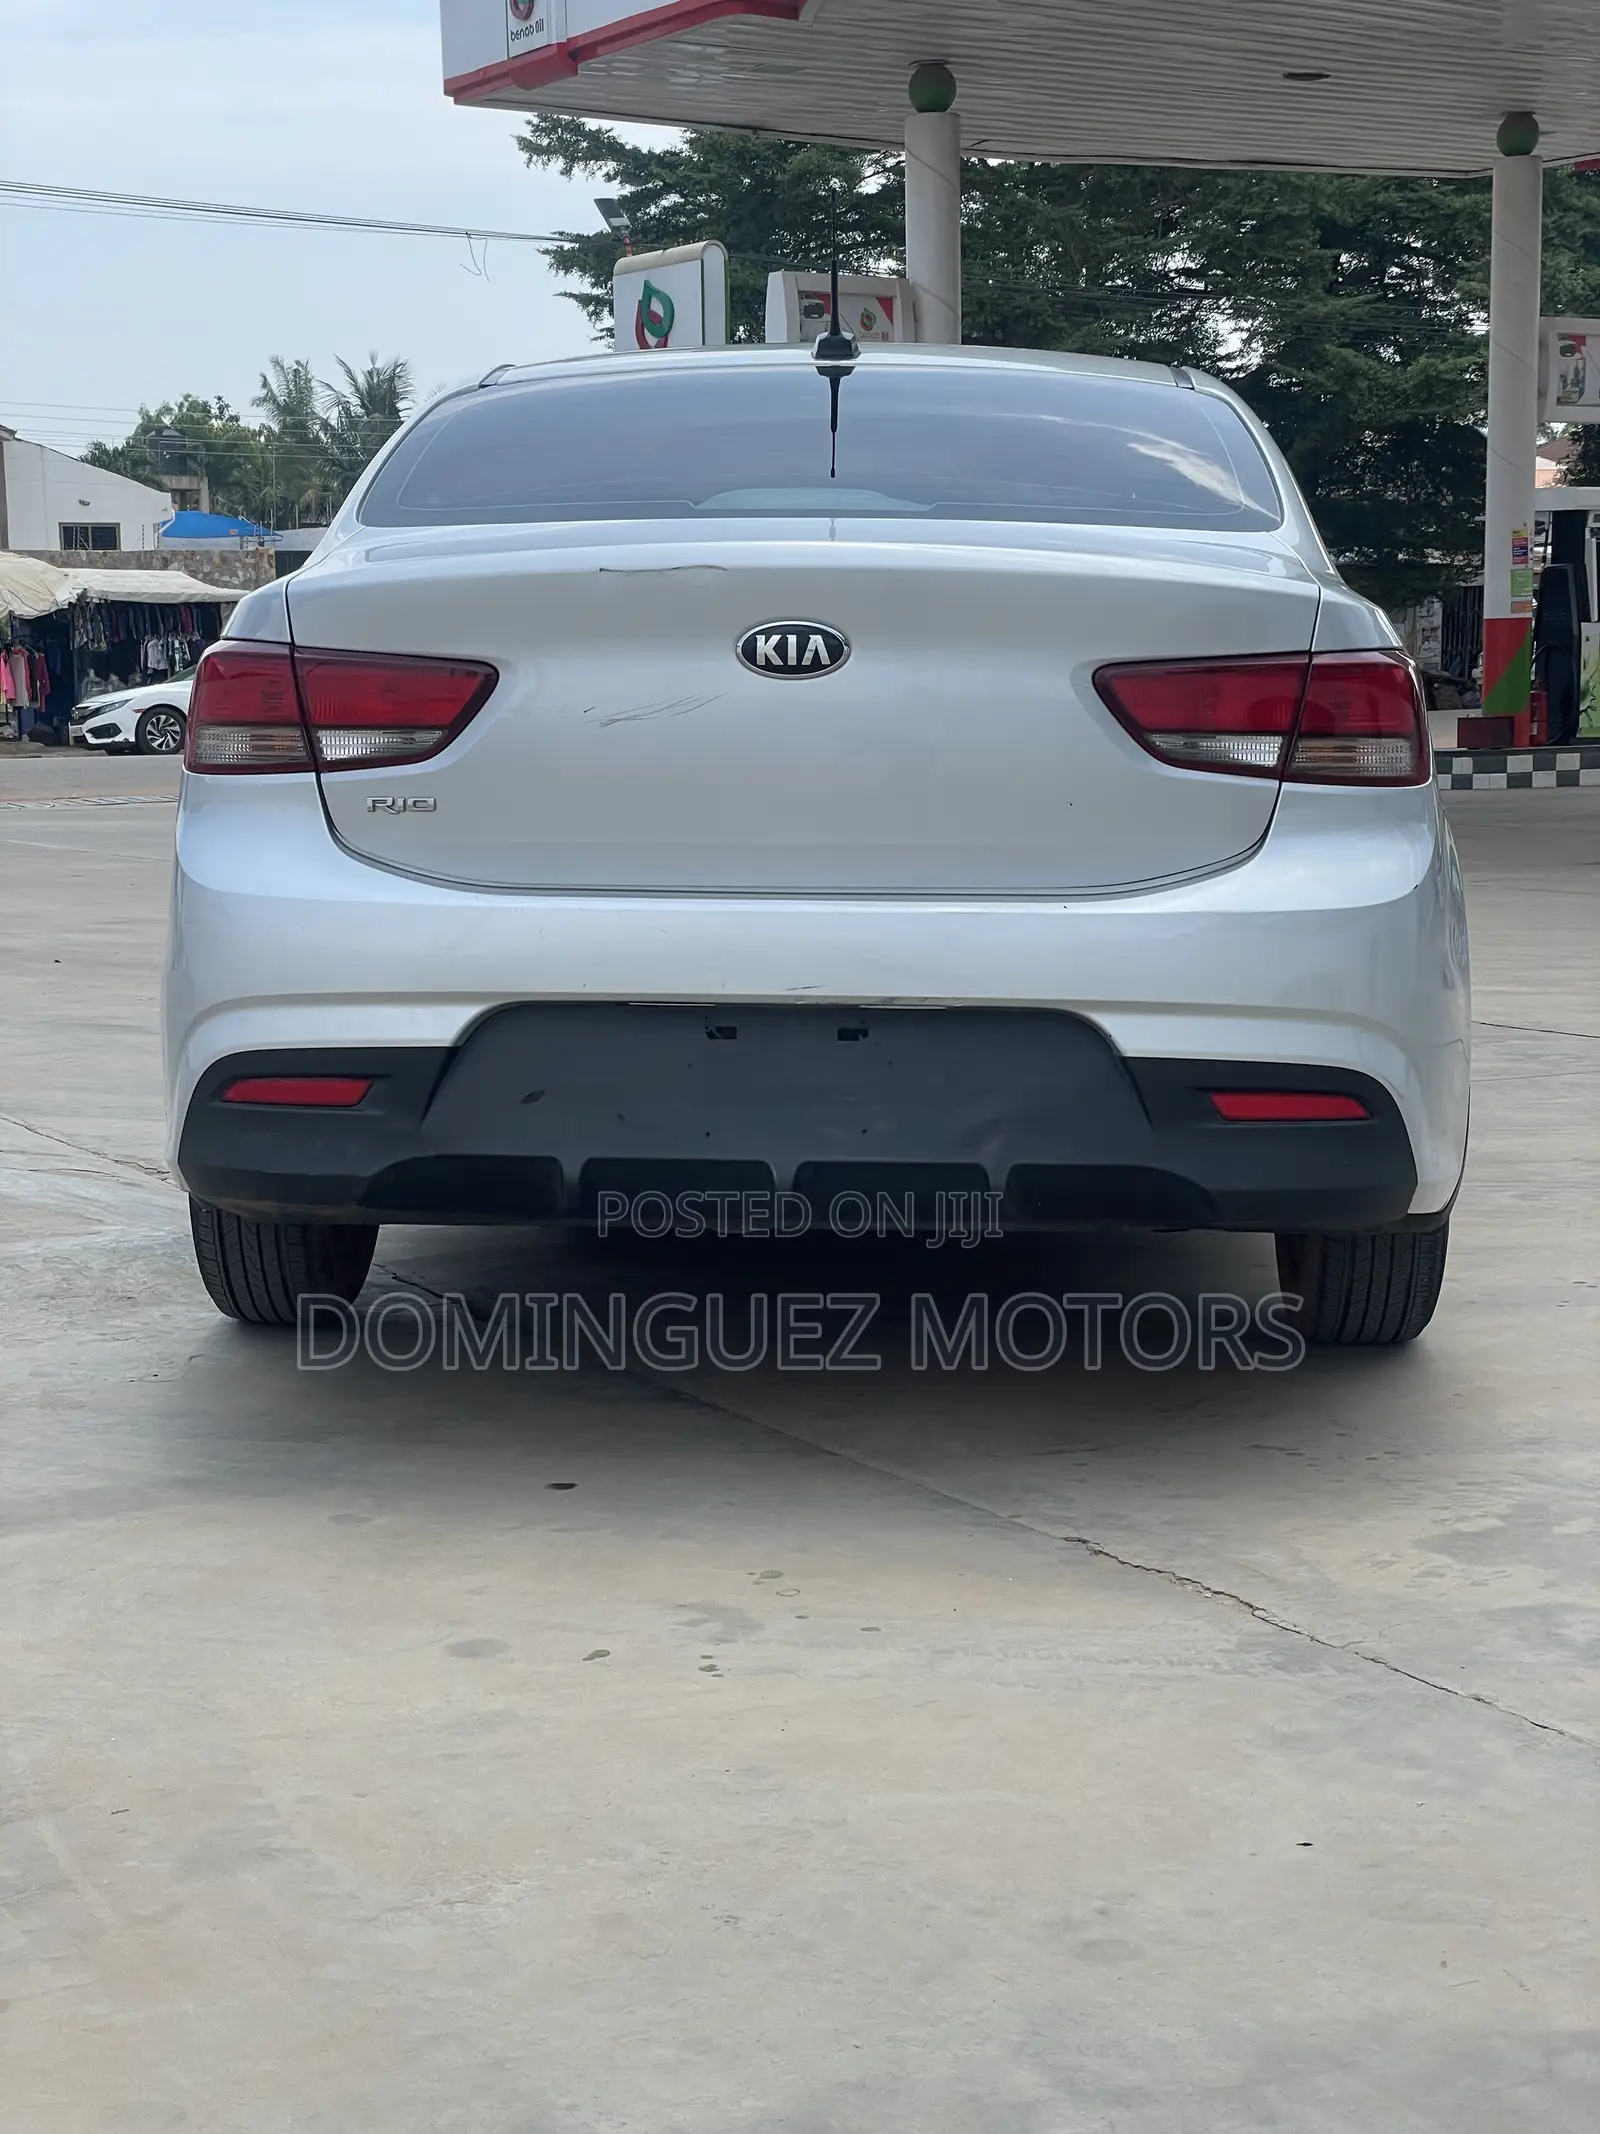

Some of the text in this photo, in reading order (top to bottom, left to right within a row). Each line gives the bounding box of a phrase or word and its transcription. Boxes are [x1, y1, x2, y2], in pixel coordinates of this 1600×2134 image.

[510, 24, 535, 42] benab
[755, 634, 831, 666] KIA
[366, 797, 436, 815] RIO
